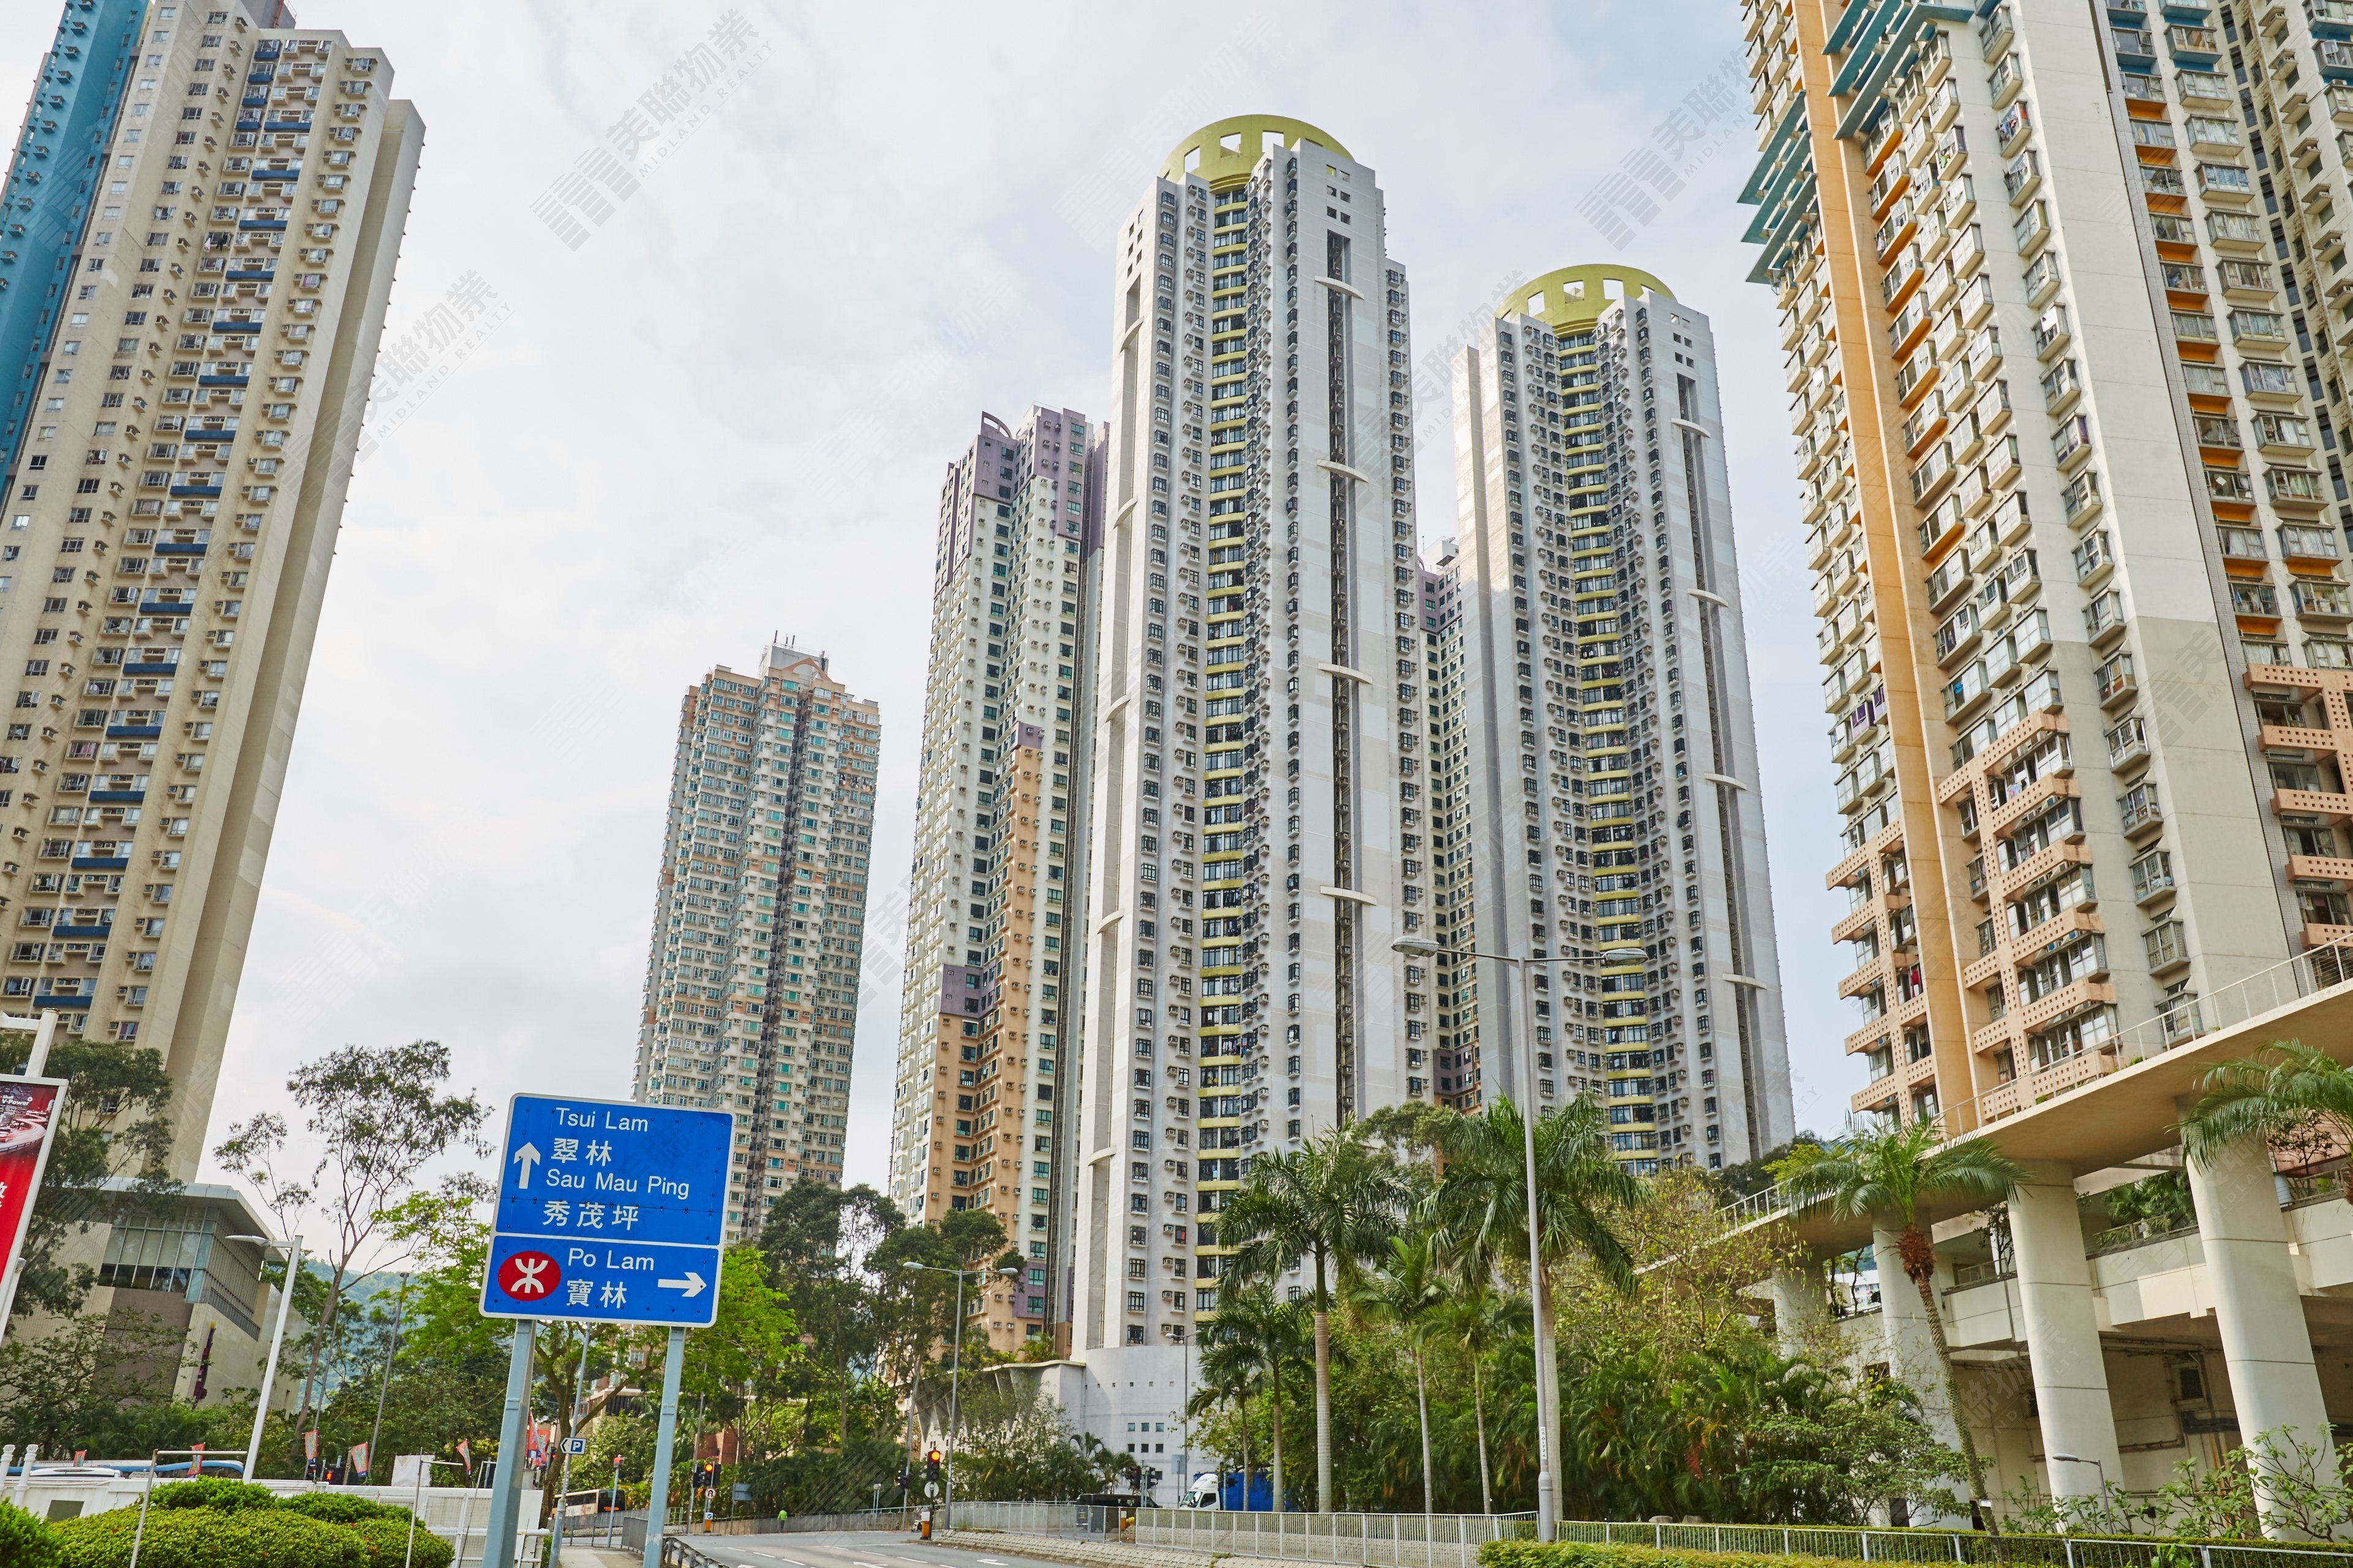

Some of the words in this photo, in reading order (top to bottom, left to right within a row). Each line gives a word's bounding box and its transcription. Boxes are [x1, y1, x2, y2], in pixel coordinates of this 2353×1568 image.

[555, 1107, 595, 1127] Tsui
[606, 1111, 649, 1131] Lam
[551, 1138, 612, 1166] 翠林
[546, 1169, 585, 1188] Sau
[596, 1172, 637, 1193] Mau
[647, 1176, 689, 1199] Ping
[543, 1201, 639, 1231] 秀茂坪
[568, 1248, 596, 1267] Po
[606, 1250, 655, 1270] Lam
[566, 1279, 627, 1308] 寶林
[573, 1441, 581, 1450] P
